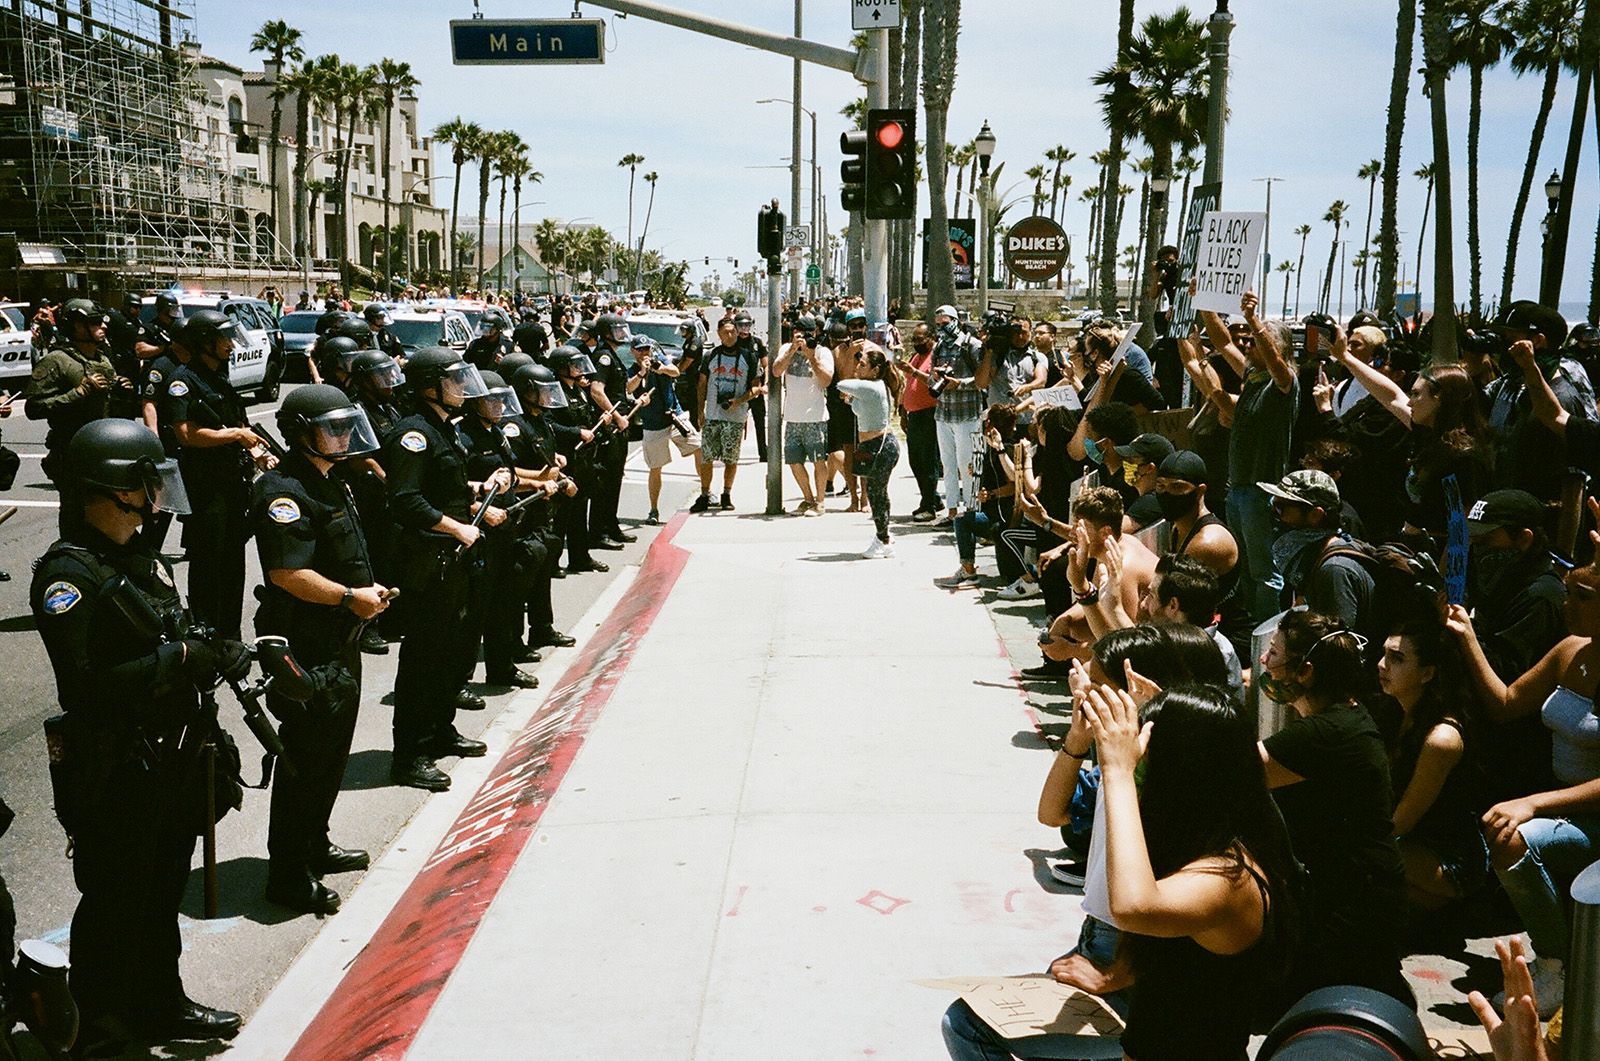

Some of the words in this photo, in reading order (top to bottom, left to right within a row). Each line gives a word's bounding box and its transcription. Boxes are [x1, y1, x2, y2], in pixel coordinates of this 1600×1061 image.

[489, 32, 563, 52] Main
[1208, 218, 1251, 244] BLACK
[1009, 235, 1065, 251] DUKE'S
[1208, 246, 1242, 269] LIVES
[1197, 270, 1246, 296] MATTER!
[1169, 322, 1192, 339] NOW
[237, 349, 264, 363] POLICE
[421, 752, 552, 874] ENTER
[987, 995, 1045, 1036] THE
